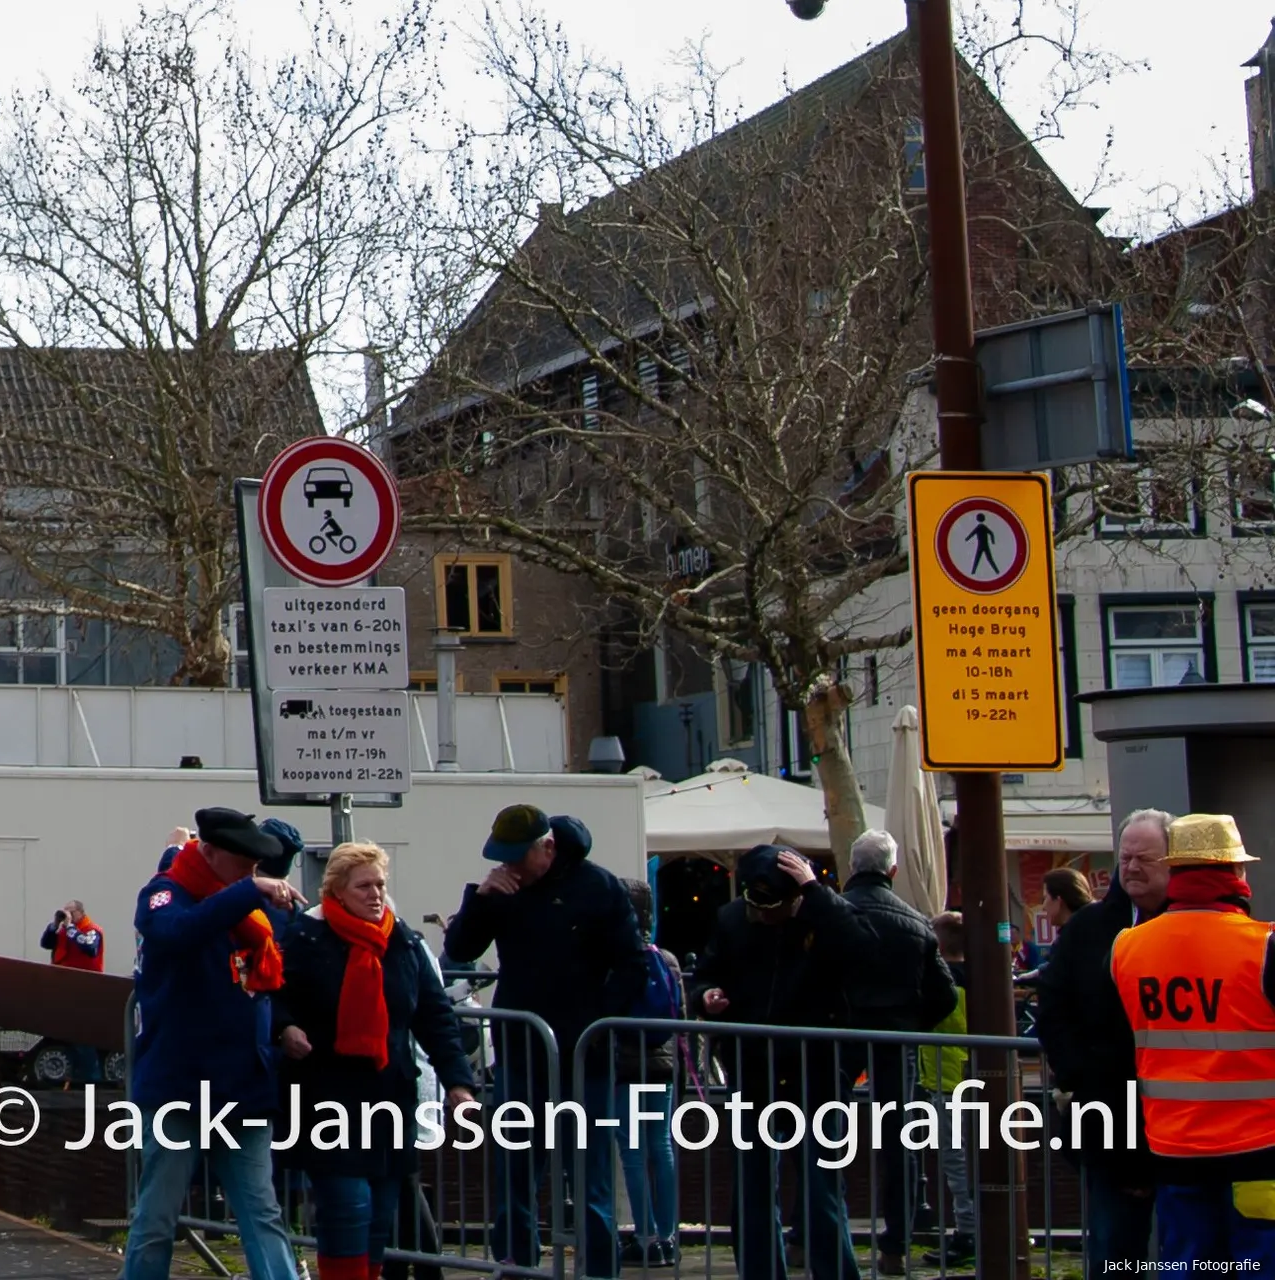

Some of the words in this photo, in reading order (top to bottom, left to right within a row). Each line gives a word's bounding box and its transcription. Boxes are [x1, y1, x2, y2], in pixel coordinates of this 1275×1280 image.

[284, 597, 386, 615] uitgezonderd
[932, 603, 967, 619] geen
[971, 602, 1040, 618] doorgang
[270, 619, 316, 633] taxi's
[320, 621, 349, 633] van
[353, 618, 401, 632] 6-20h
[948, 623, 985, 638] Hoge
[990, 623, 1026, 639] Brug
[273, 643, 292, 655] en
[297, 640, 401, 657] bestemmings
[946, 647, 967, 658] ma
[972, 646, 983, 658] 4
[987, 646, 1031, 658] maart
[288, 662, 348, 676] verkeer
[353, 661, 389, 675] KMA
[965, 665, 1013, 678] 10-18h
[952, 689, 966, 701] di
[970, 689, 980, 701] 5
[985, 688, 1029, 701] maart
[328, 704, 402, 719] toegestaan
[966, 708, 1017, 721] 19-22h
[307, 728, 327, 740] ma
[331, 726, 357, 740] t/m
[361, 729, 376, 740] vr
[296, 748, 321, 760] 7-11
[325, 749, 341, 760] en
[345, 747, 387, 760] 17-19h
[282, 769, 353, 782] koopavond
[357, 768, 403, 780] 21-22h
[1138, 976, 1224, 1024] BCV
